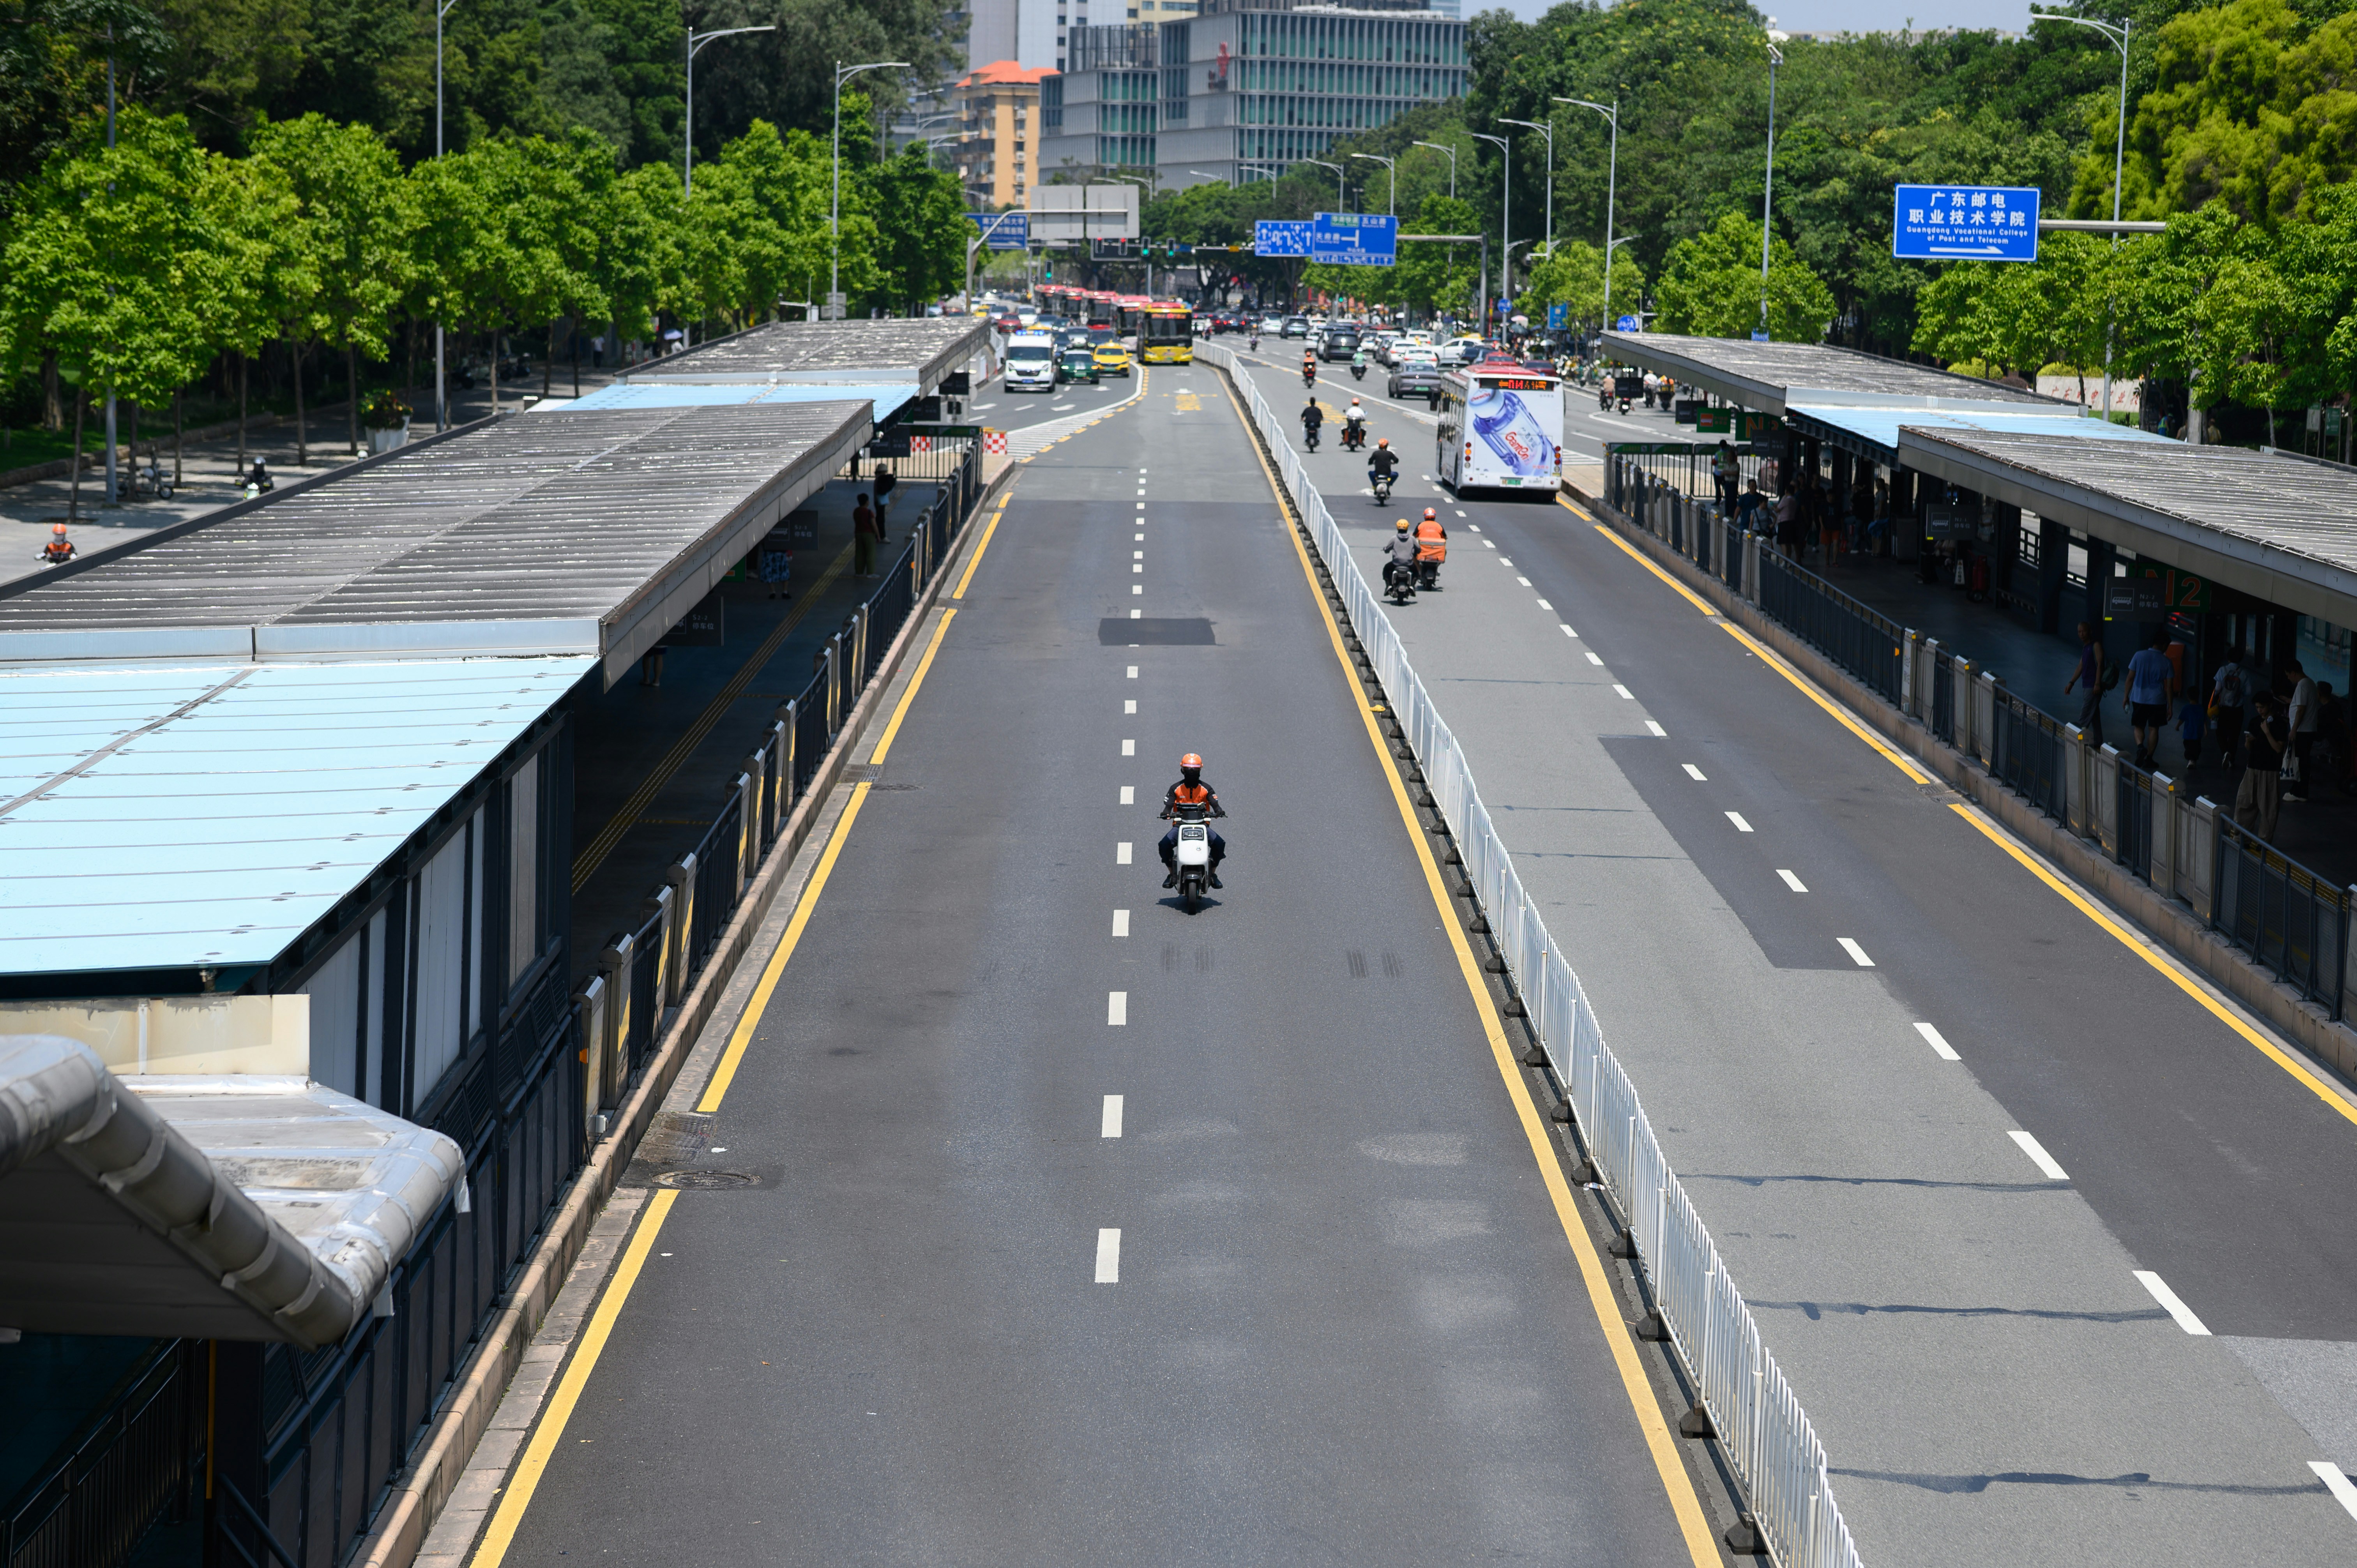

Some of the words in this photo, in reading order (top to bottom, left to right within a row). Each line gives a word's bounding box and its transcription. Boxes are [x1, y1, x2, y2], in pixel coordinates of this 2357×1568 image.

[1930, 191, 2006, 208] 广东邮电
[1908, 208, 2025, 227] 职业技术学院
[1906, 226, 1950, 235] Guangdong
[1954, 227, 1995, 235] Vocational
[1999, 228, 2028, 238] College
[1978, 236, 2009, 244] Telecom
